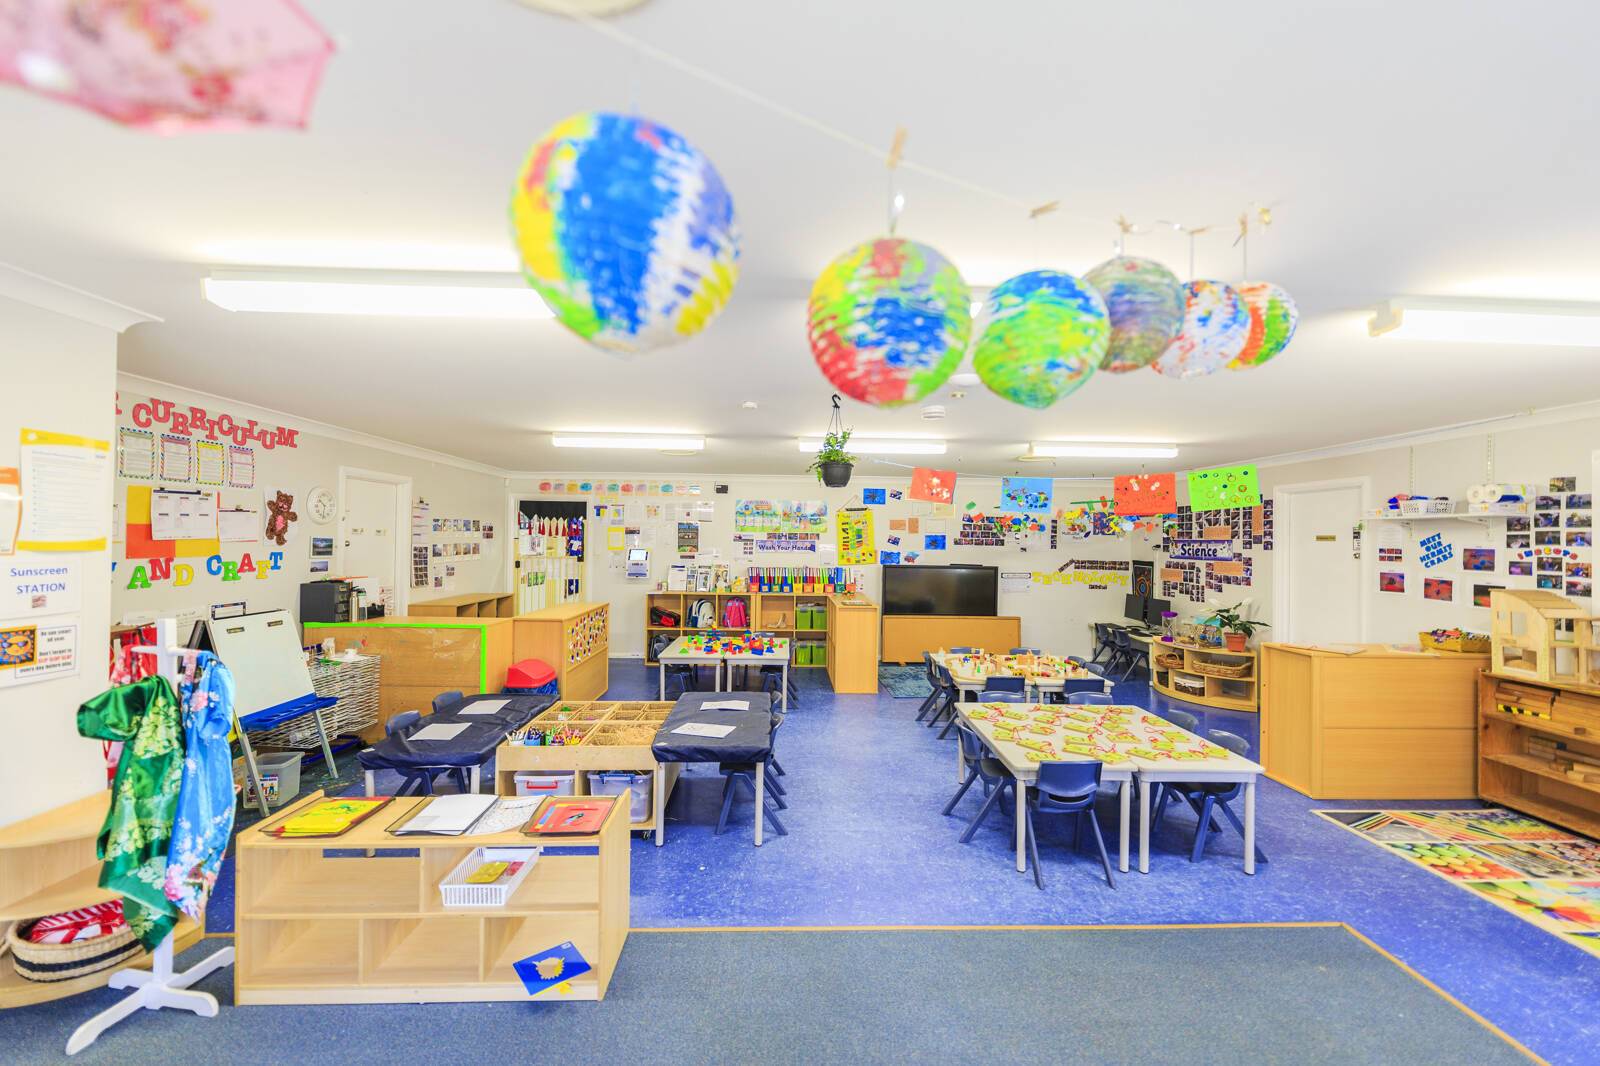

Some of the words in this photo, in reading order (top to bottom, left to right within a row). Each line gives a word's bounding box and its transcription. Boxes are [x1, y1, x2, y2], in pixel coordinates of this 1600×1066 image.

[132, 398, 299, 450] CURRICULUM
[1419, 533, 1441, 548] MEET
[1424, 540, 1443, 552] OUR
[1180, 543, 1218, 557] Science
[1419, 543, 1453, 563] HERMIT
[1424, 551, 1454, 568] CRABS
[10, 567, 68, 577] Sunscreen
[126, 556, 195, 590] AND
[206, 551, 284, 581] CRAFT
[16, 583, 66, 594] STATION
